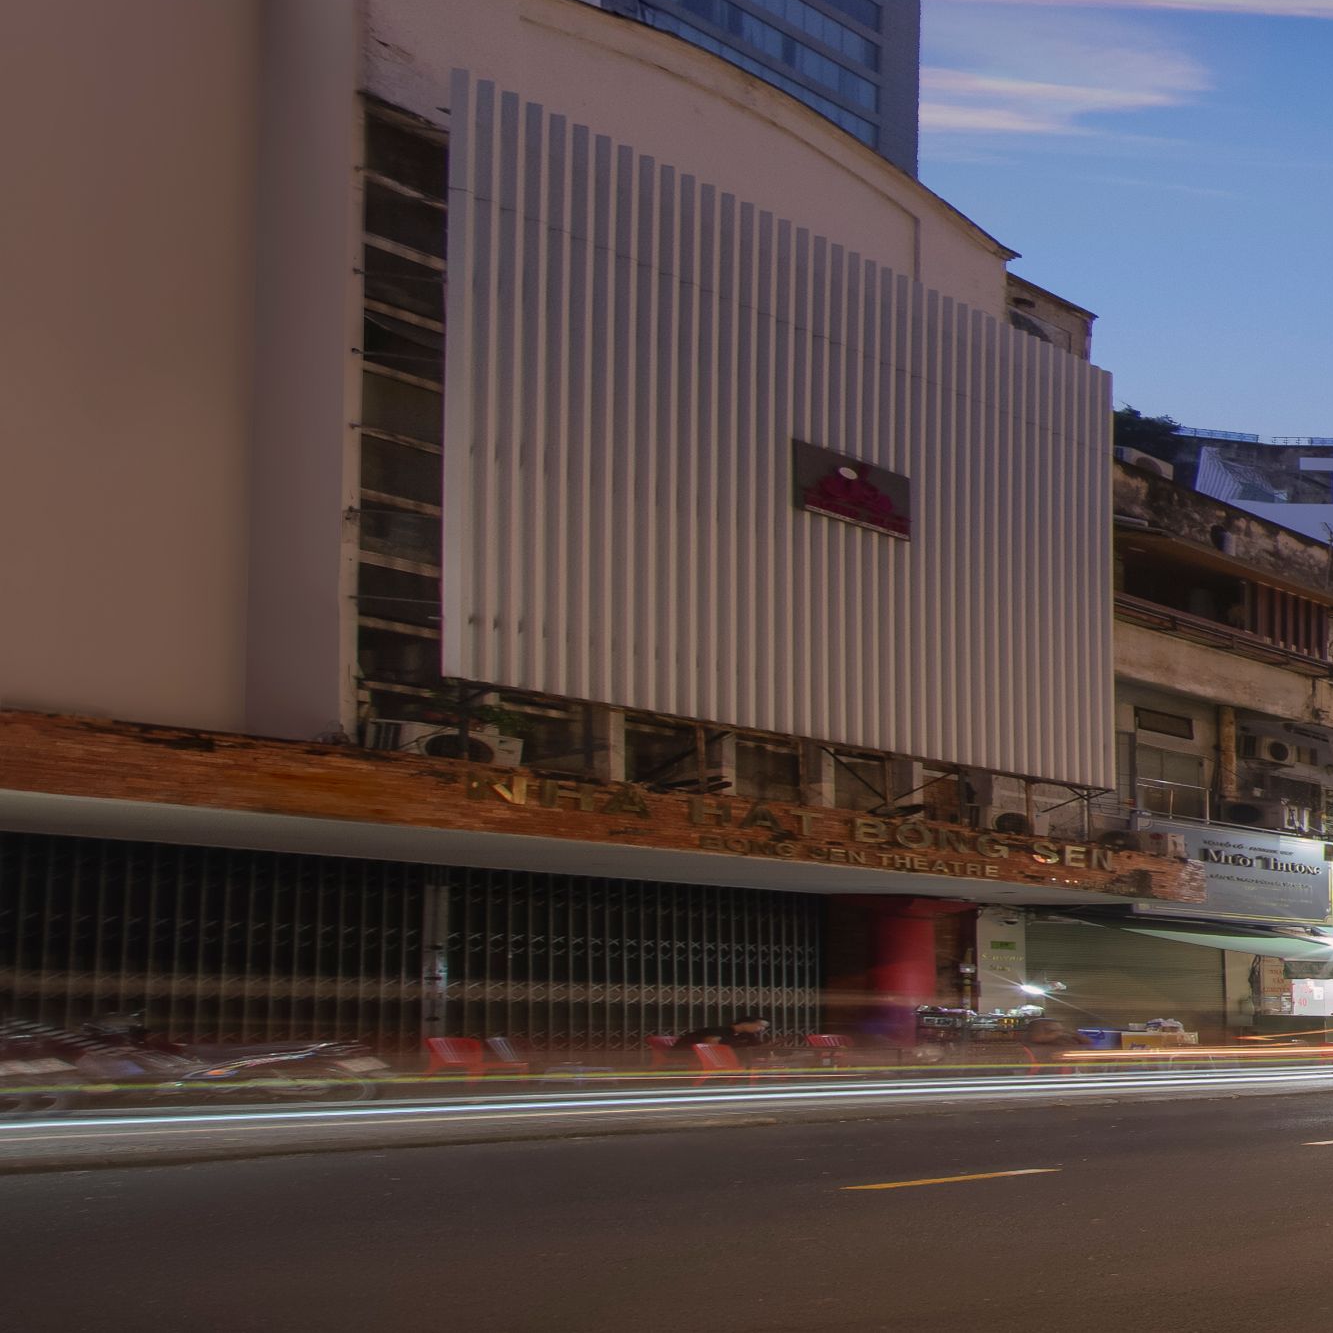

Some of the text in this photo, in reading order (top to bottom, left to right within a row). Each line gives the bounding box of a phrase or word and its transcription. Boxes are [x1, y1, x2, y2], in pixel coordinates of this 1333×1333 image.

[808, 845, 867, 864] SEN
[876, 852, 1000, 878] THEATRE
[1033, 841, 1114, 872] SEN
